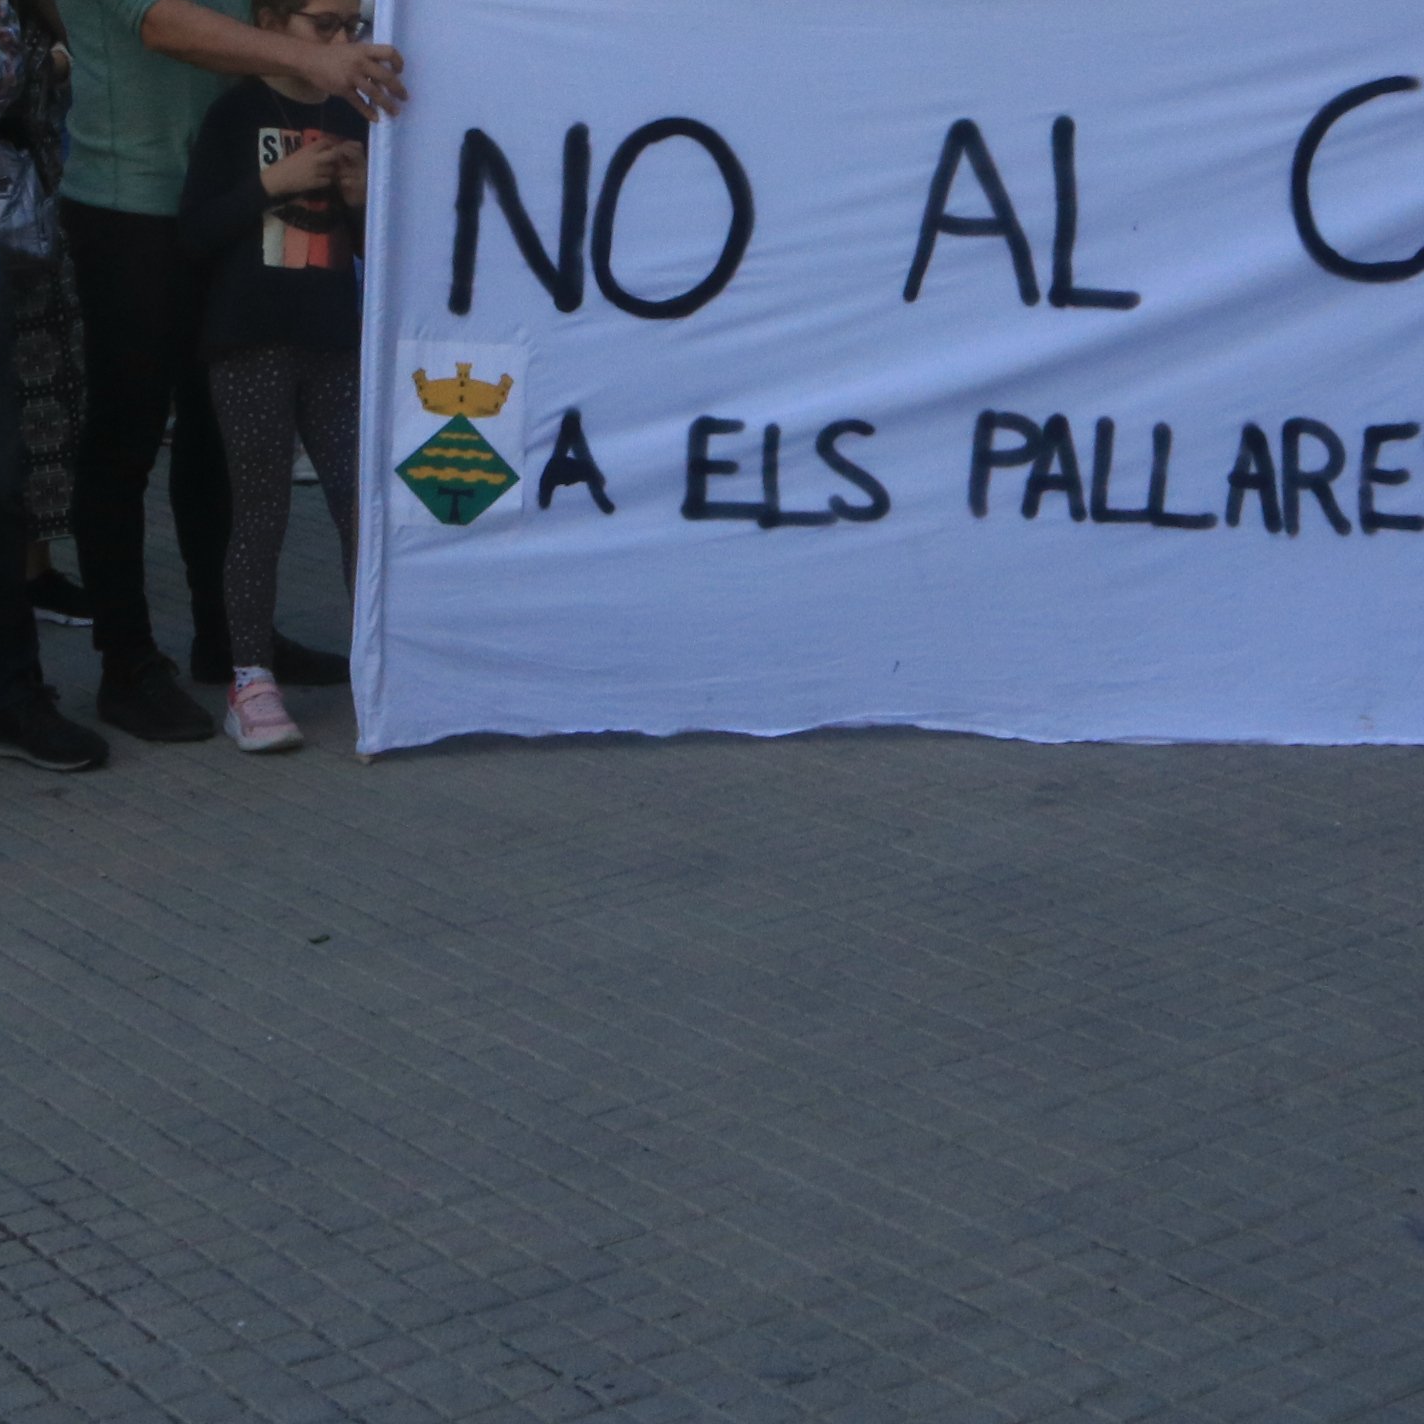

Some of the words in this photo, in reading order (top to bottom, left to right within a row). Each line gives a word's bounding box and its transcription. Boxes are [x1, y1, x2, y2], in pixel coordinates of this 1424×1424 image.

[447, 117, 754, 320] NO
[902, 116, 1139, 310] AL
[537, 407, 616, 515] A
[680, 416, 891, 530] ELS
